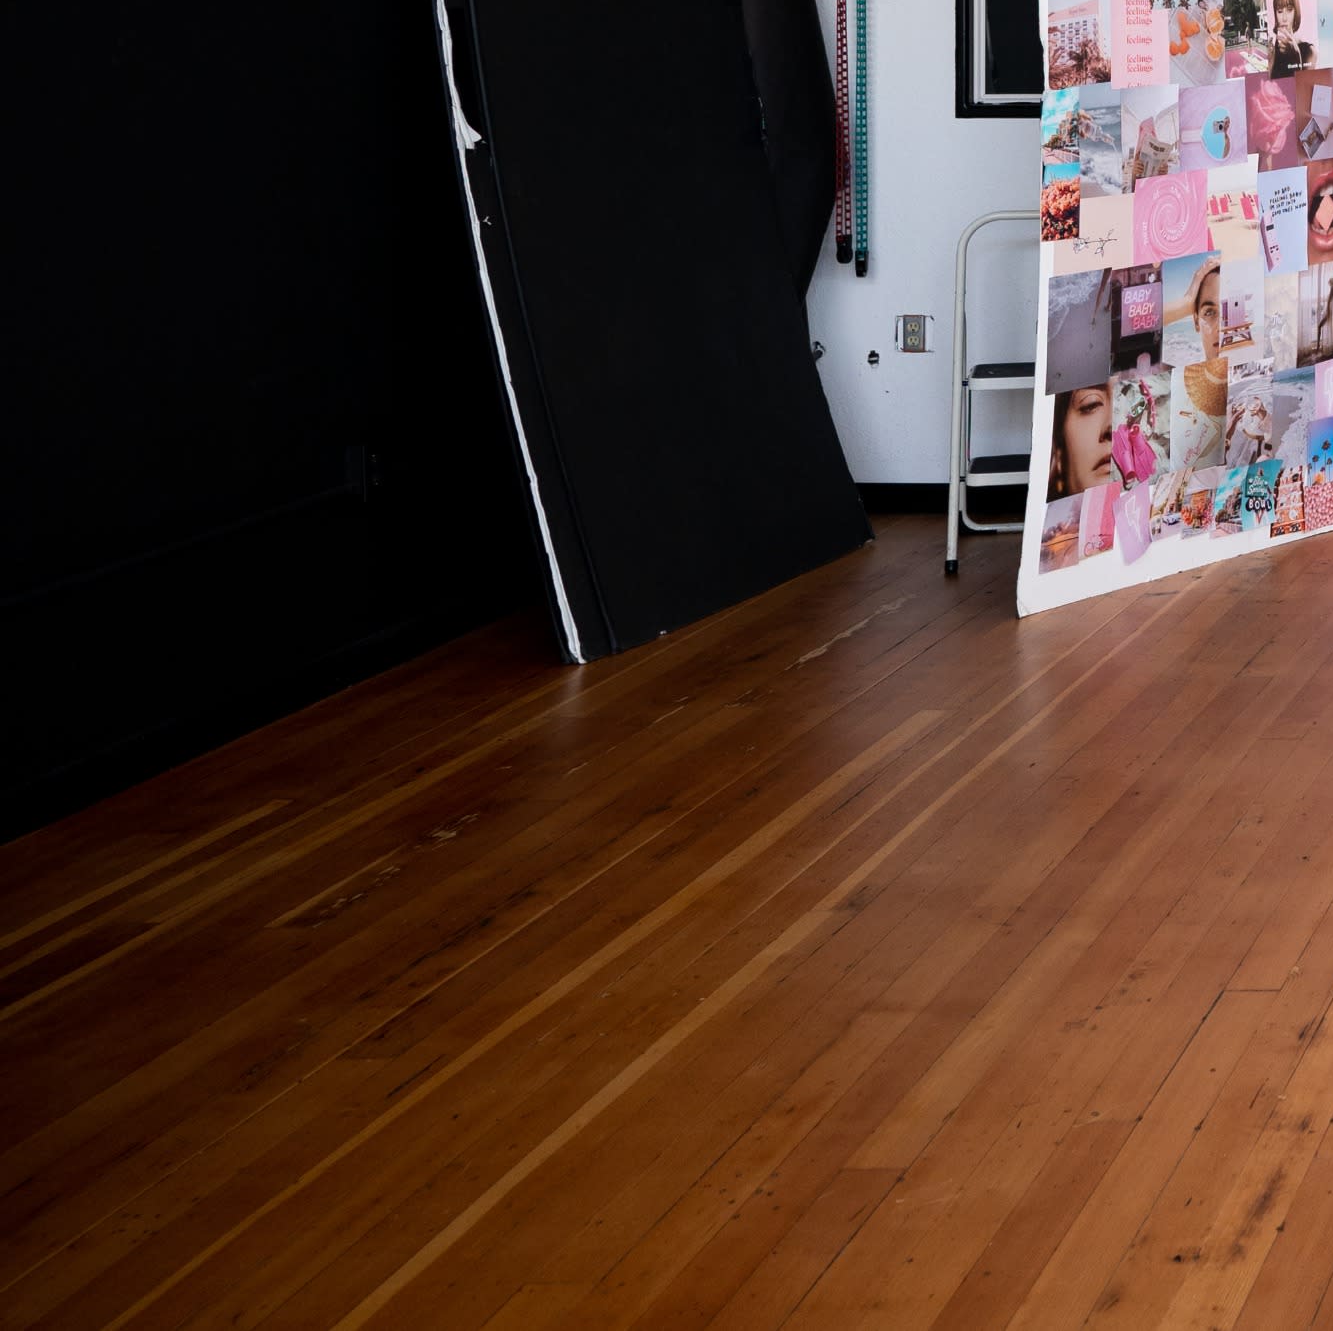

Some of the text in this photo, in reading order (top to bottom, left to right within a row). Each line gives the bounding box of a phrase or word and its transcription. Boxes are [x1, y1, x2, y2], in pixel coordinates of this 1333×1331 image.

[1126, 16, 1153, 26] feelings
[1126, 35, 1153, 45] feelings
[1126, 54, 1153, 64] feelings
[1126, 63, 1154, 74] feelings
[1124, 288, 1152, 305] BABY
[1128, 301, 1156, 319] BABY
[1132, 314, 1160, 331] BABY
[1248, 497, 1272, 510] BOWL
